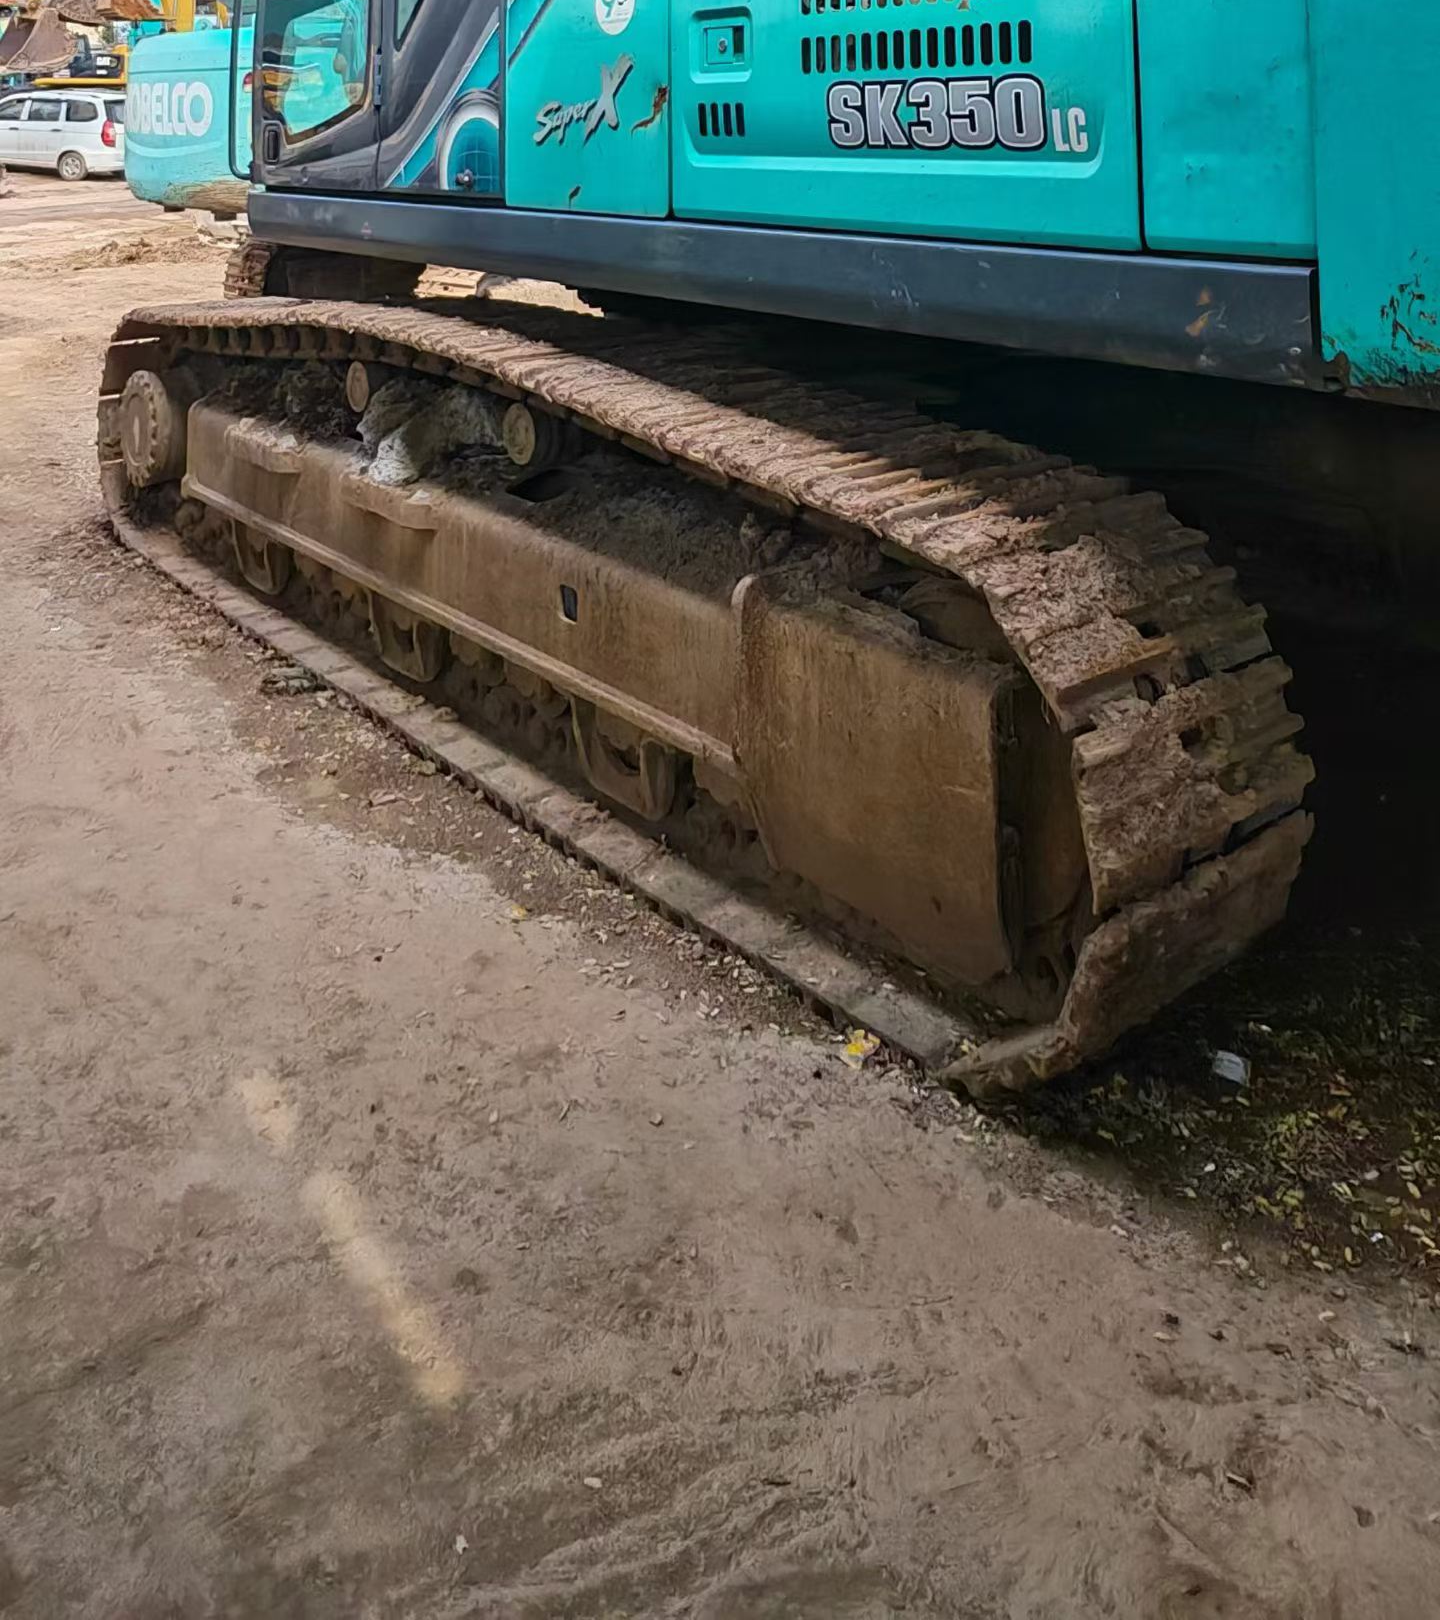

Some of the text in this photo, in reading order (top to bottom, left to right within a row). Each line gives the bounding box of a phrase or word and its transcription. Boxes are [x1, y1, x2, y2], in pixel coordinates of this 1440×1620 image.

[533, 53, 634, 148] Super X
[826, 73, 1088, 153] SK350 LC
